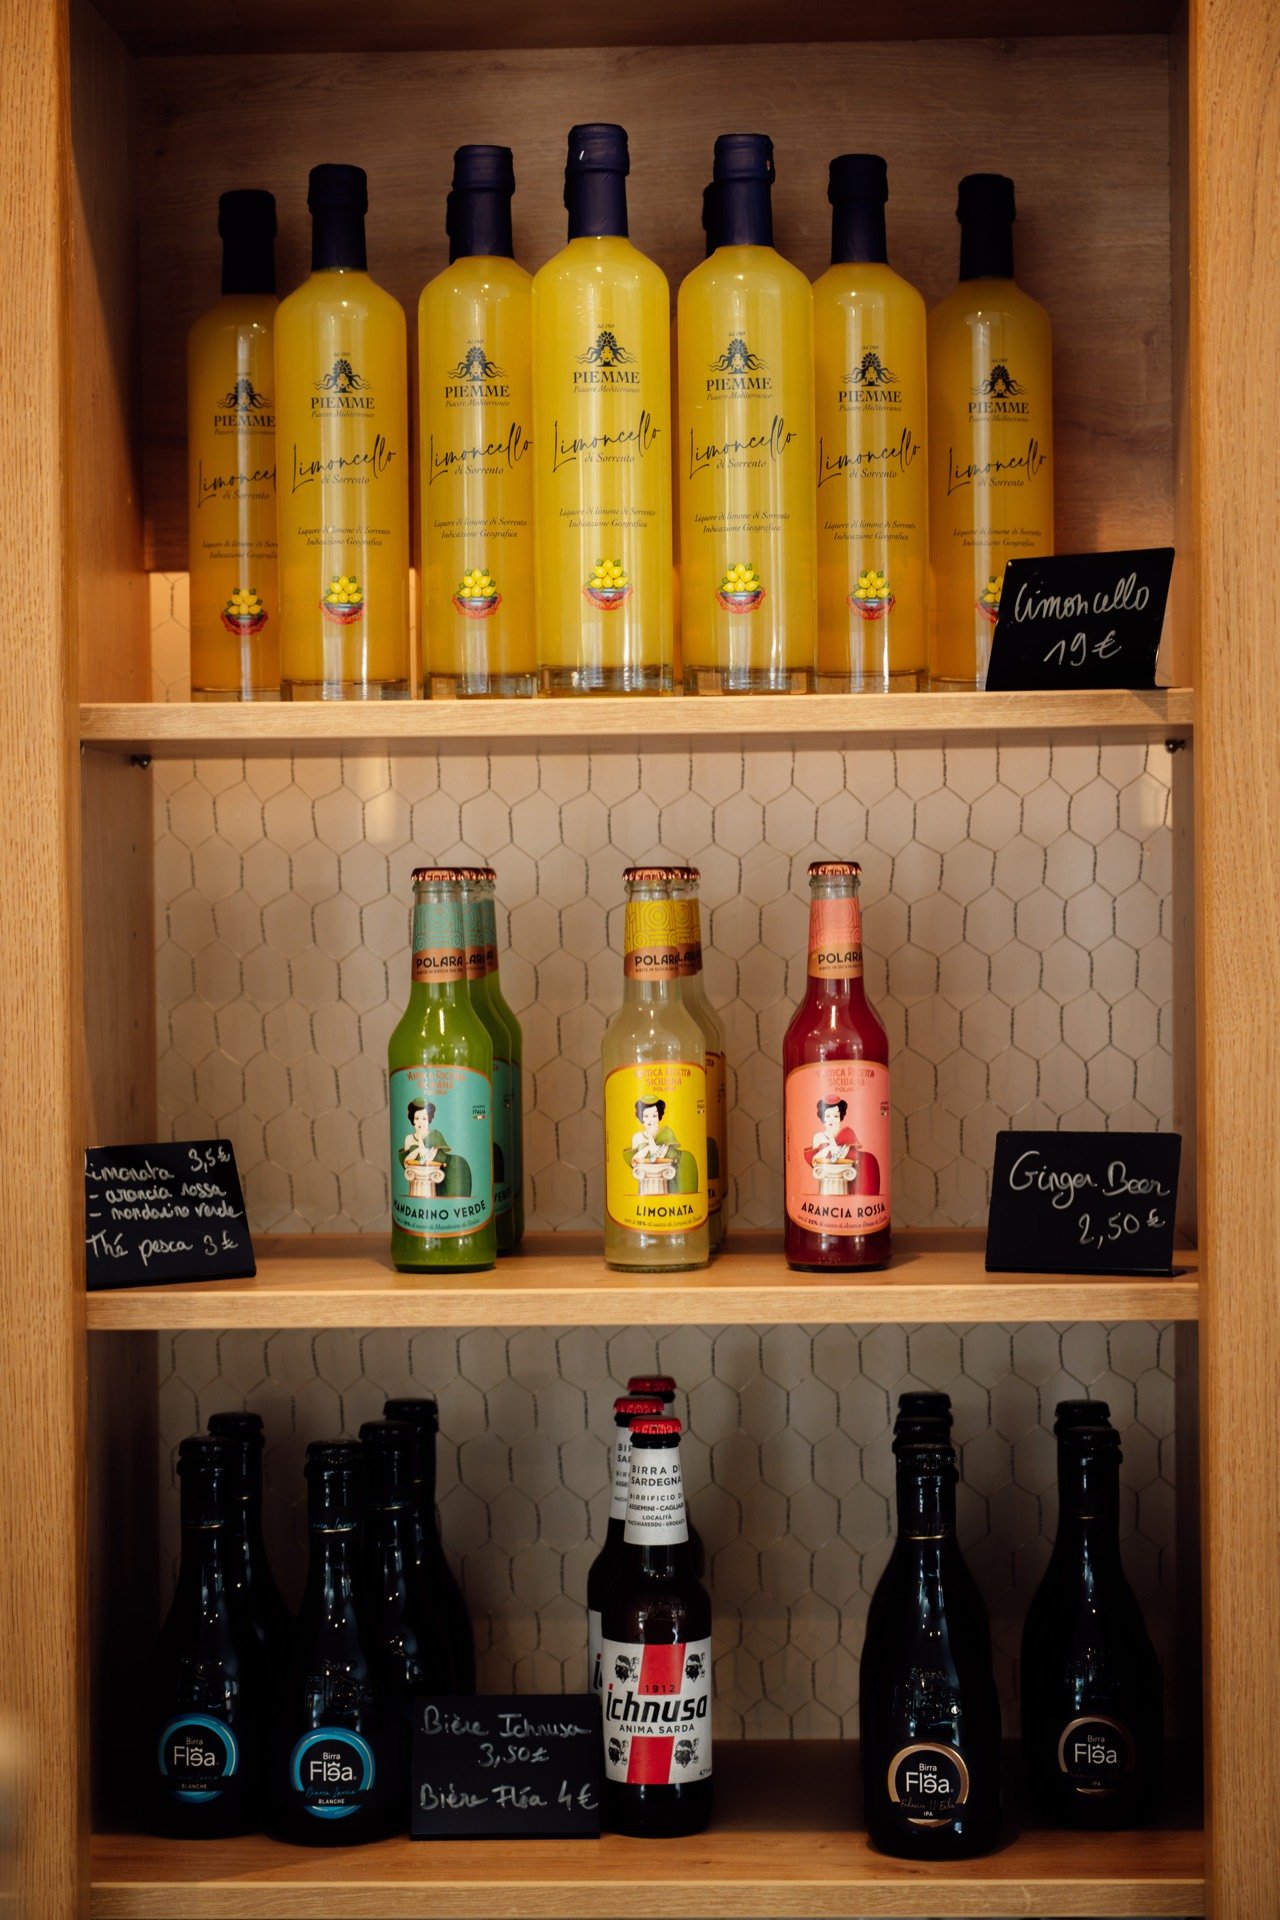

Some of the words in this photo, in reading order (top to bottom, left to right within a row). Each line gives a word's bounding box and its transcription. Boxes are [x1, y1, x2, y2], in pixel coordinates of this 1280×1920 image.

[573, 371, 640, 384] PIEMME
[706, 378, 772, 391] PIEMME
[445, 386, 510, 398] PIEMME
[839, 391, 902, 403] PIEMME
[311, 398, 375, 409] PIEMME
[968, 403, 1029, 413] PIEMME
[214, 415, 275, 426] PIEMME
[553, 409, 661, 473] Limoncello
[690, 415, 796, 479] Limoncello
[429, 422, 533, 485] Limoncello
[585, 454, 593, 462] di
[596, 453, 634, 462] Sorrento
[818, 427, 920, 488] Limoncello
[292, 434, 396, 493] Limoncello
[466, 464, 504, 475] Sorrento
[717, 459, 725, 469] di
[728, 459, 767, 468] Sorrento
[948, 437, 1046, 496] Limoncello
[333, 474, 369, 484] Sorrento
[861, 468, 897, 478] Sorrento
[198, 459, 276, 508] Limoncel
[1014, 571, 1150, 623] Limoncello
[417, 956, 462, 968] POLARA
[635, 954, 678, 966] POLARA
[818, 952, 862, 964] POLARA
[1010, 1150, 1098, 1209] Ginger
[1103, 1161, 1170, 1196] Beer
[106, 1185, 172, 1203] arancia
[181, 1183, 227, 1198] rossa
[195, 1201, 243, 1218] verde
[454, 1200, 485, 1217] VERDE
[637, 1205, 693, 1217] LIMONATA
[801, 1202, 851, 1217] ARANCIA
[858, 1202, 885, 1217] ROSSA
[86, 1229, 128, 1258] Thé
[138, 1239, 193, 1266] pesca
[632, 1465, 667, 1475] BIRRA
[631, 1476, 681, 1486] SARDEGNA
[630, 1493, 675, 1501] BIRRIFICIO
[660, 1503, 684, 1511] CAGLIAR
[645, 1685, 675, 1693] 1912
[606, 1683, 707, 1722] ichnusa
[420, 1705, 489, 1737] Bière
[497, 1714, 592, 1738] Ichnusa
[620, 1725, 653, 1733] ANIMA
[659, 1724, 694, 1733] SARDA
[186, 1737, 203, 1746] Birra
[1088, 1734, 1105, 1743] Birra
[323, 1752, 341, 1760] Birra
[919, 1763, 937, 1772] Birra
[420, 1783, 488, 1810] Bière
